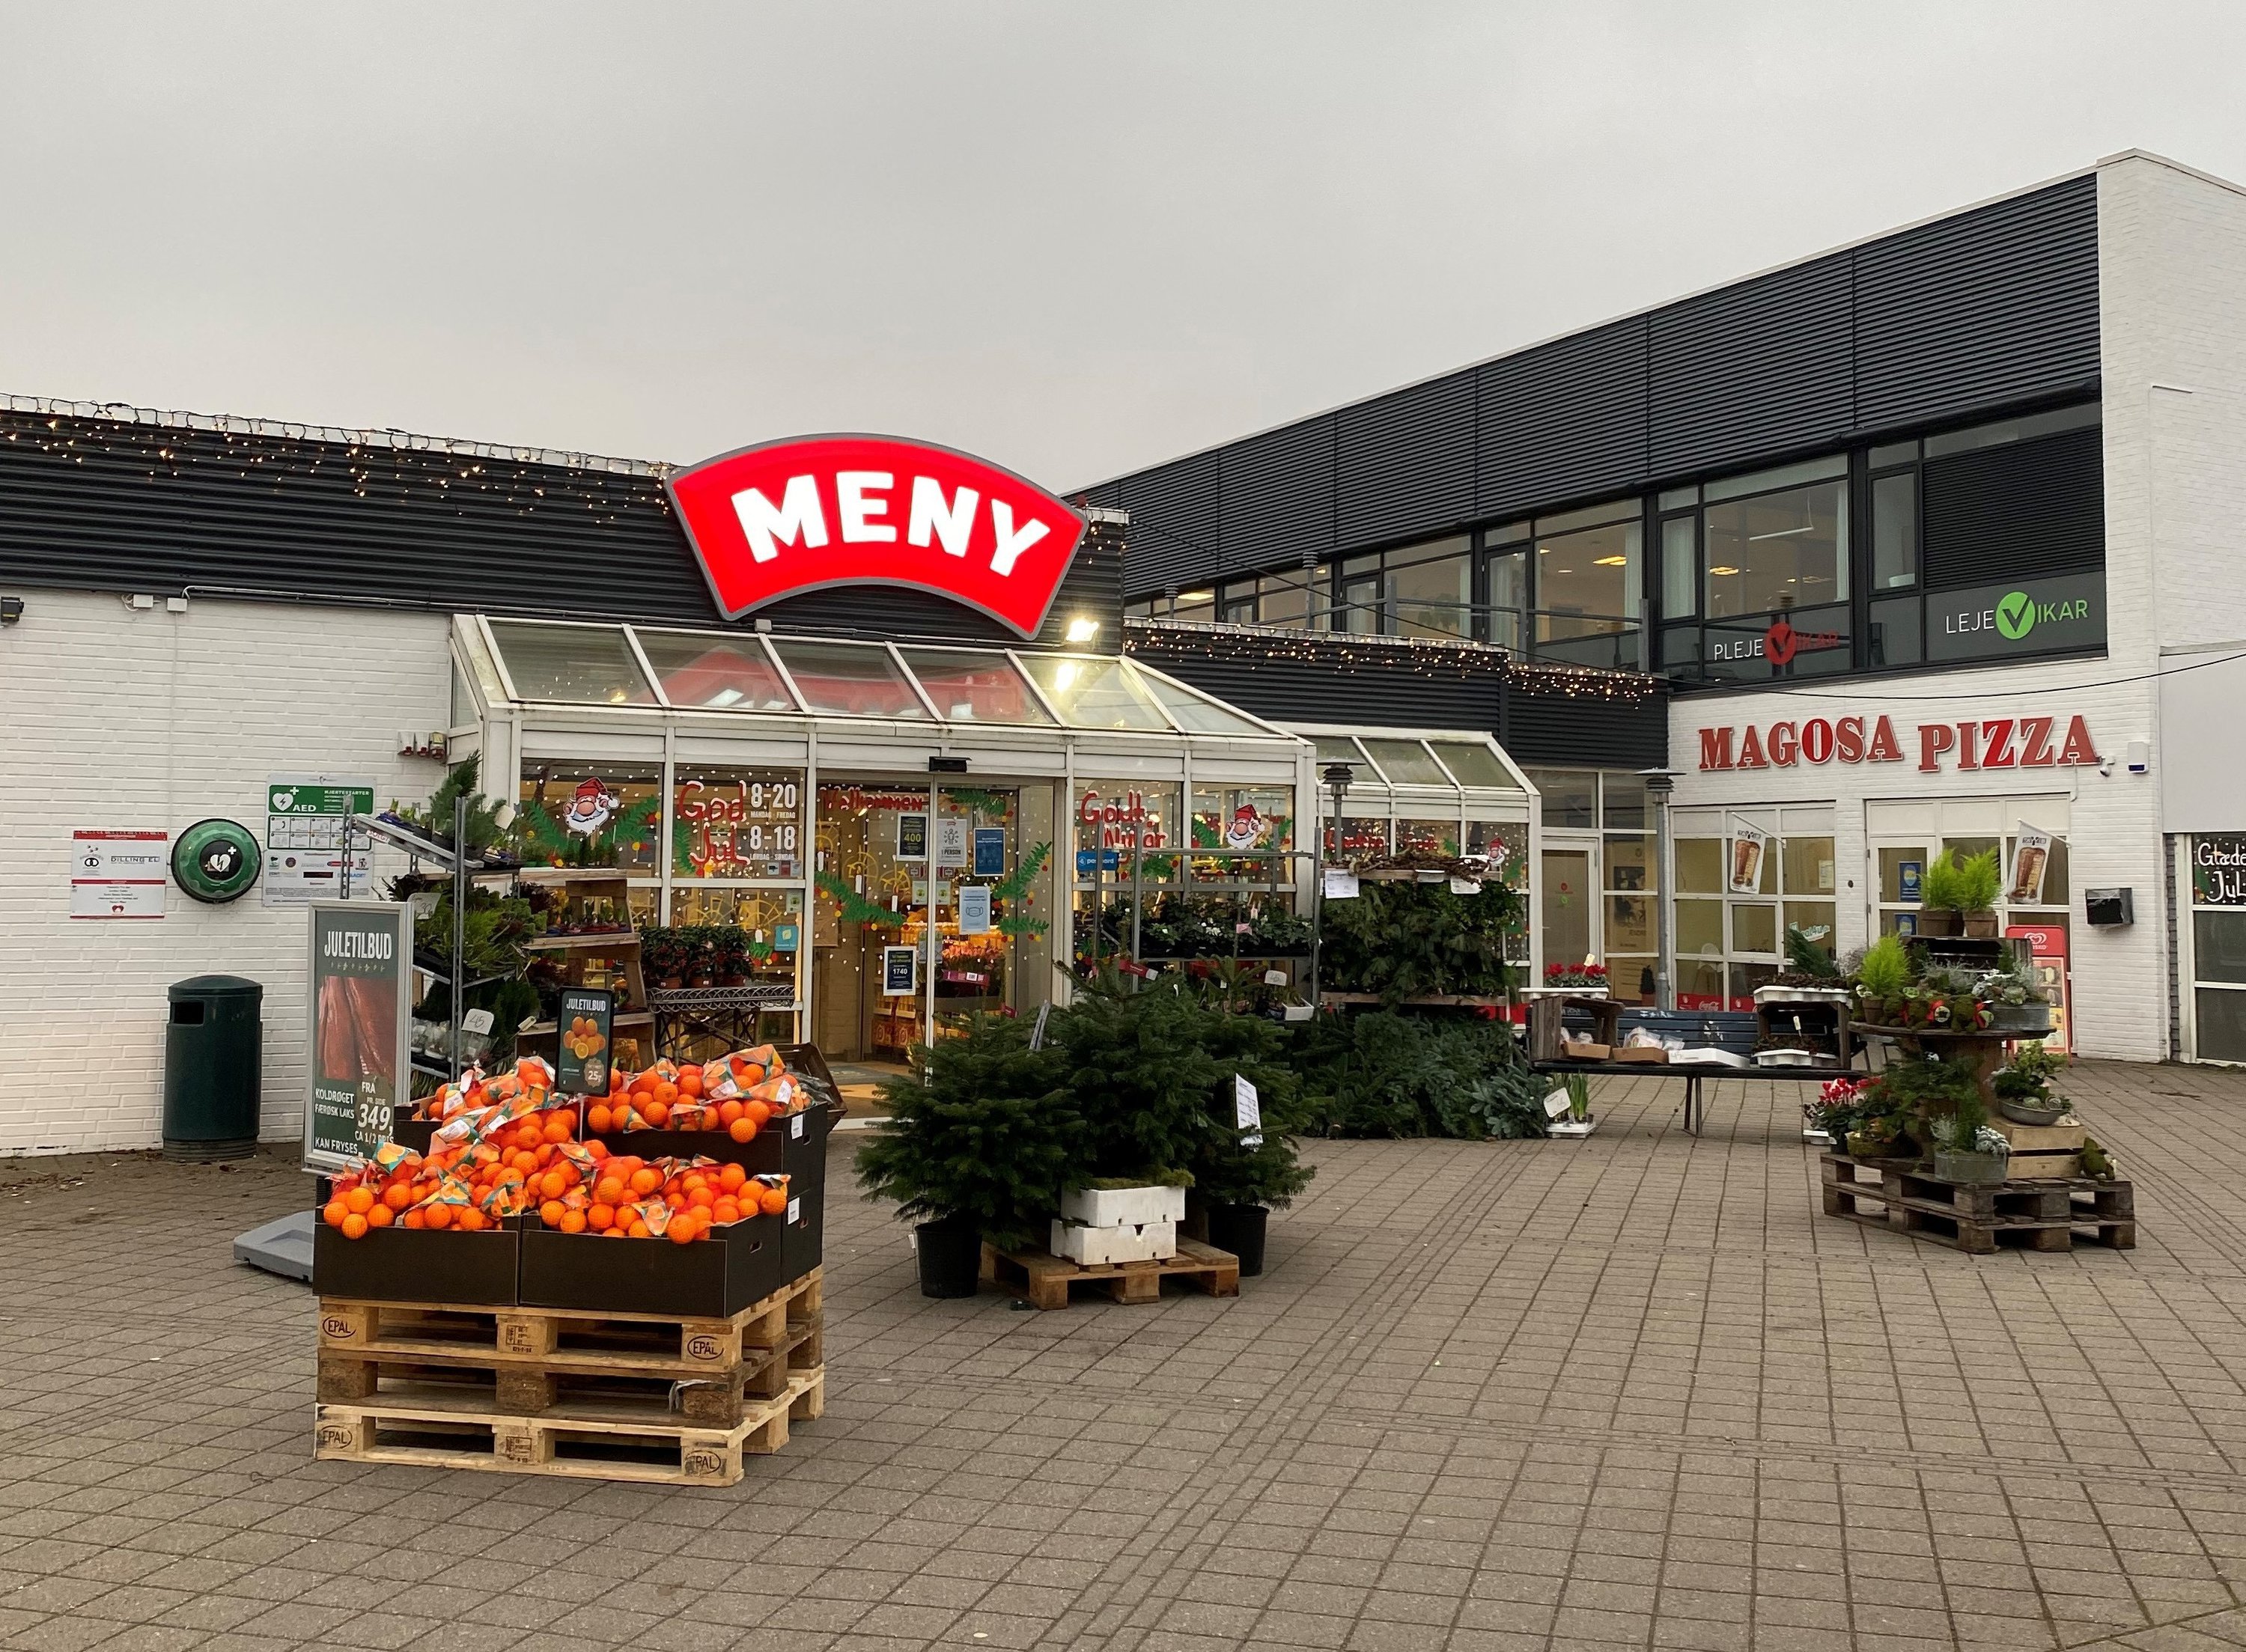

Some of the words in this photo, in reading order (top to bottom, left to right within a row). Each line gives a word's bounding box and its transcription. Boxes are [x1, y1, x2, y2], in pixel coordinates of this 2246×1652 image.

[730, 469, 1051, 578] MENY
[1698, 714, 1904, 772] MAGOSA
[1917, 714, 2102, 772] PIZZA
[678, 780, 747, 822] God
[751, 783, 797, 808] 8-20
[292, 804, 317, 812] AED
[776, 811, 796, 819] FREDAG
[1080, 790, 1148, 826] Godt
[690, 821, 751, 866] Jul
[749, 825, 796, 850] 8-18
[904, 833, 922, 843] 400
[323, 930, 392, 960] JULETILBUD
[566, 998, 606, 1012] JULETILBUD
[314, 1087, 355, 1105] KOLDRØGET
[362, 1081, 377, 1094] FRA
[314, 1103, 339, 1118] FÆRØSK
[338, 1106, 355, 1120] LAKS
[314, 1136, 329, 1149] KAN
[354, 1130, 364, 1142] CA
[365, 1132, 377, 1145] 1/2
[328, 1320, 352, 1334] EPAL
[693, 1341, 719, 1356] EPAL
